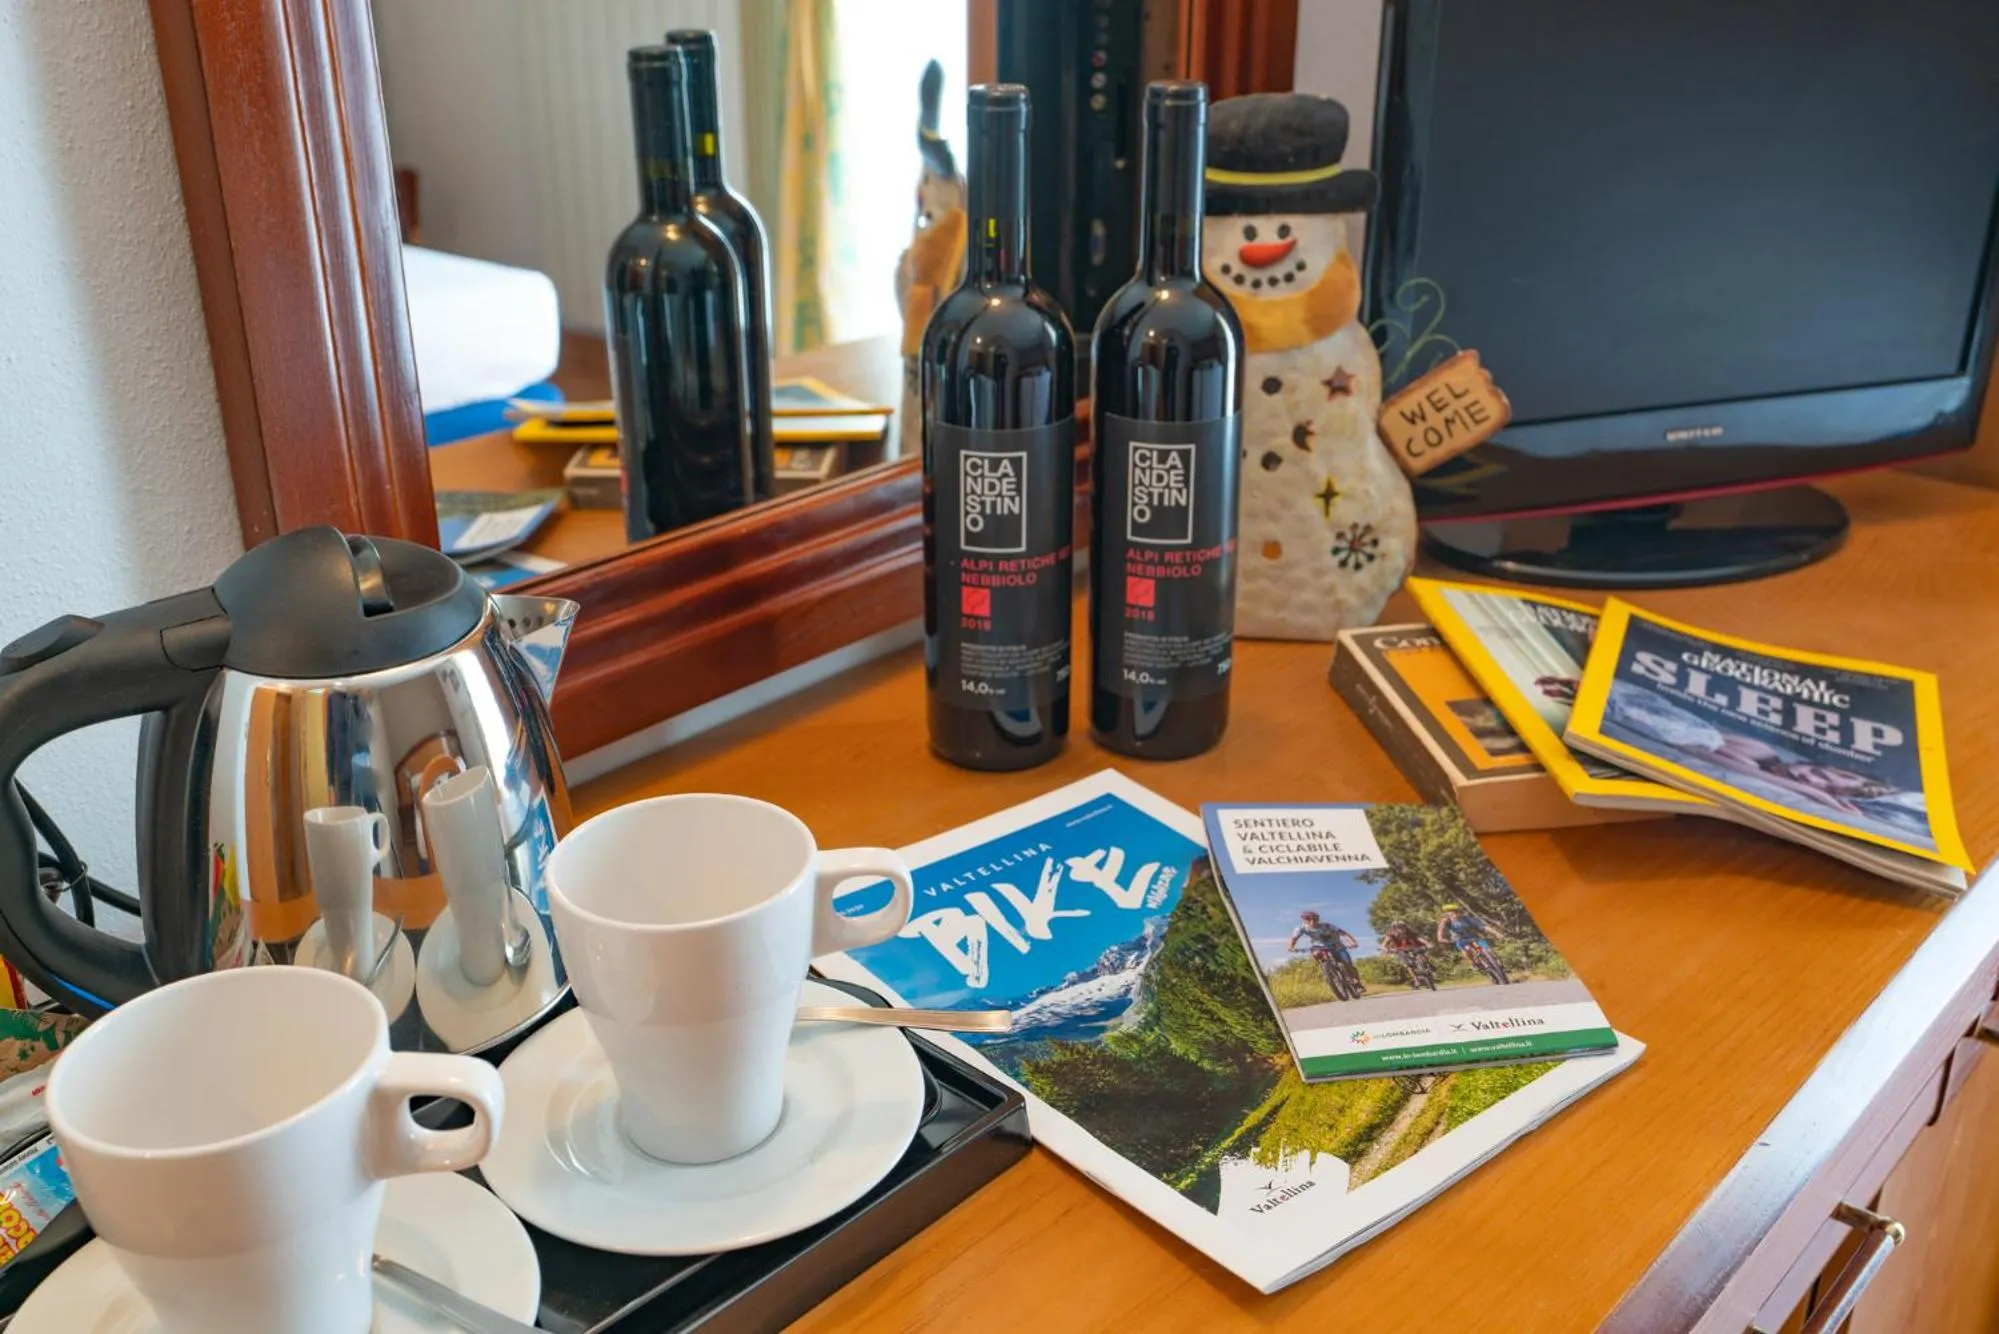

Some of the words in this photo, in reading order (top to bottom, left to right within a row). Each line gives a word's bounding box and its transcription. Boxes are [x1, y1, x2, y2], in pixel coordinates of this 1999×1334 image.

[1399, 382, 1470, 425] WEL
[1405, 400, 1491, 458] COME
[965, 457, 1015, 476] CLA
[1134, 449, 1183, 469] CLA
[965, 475, 1017, 496] NDE
[1134, 467, 1185, 488] NDE
[965, 494, 1020, 515] STIN
[1133, 486, 1187, 507] STIN
[961, 558, 993, 571] ALPI
[998, 552, 1057, 572] RETICHE
[1126, 548, 1159, 562] ALPI
[1164, 545, 1221, 563] RETICHE
[961, 571, 1037, 588] NEBBIOLO
[1126, 563, 1201, 578] NEBBIOLO
[1681, 651, 1850, 709] GEOGRAPHIC
[1702, 650, 1834, 694] NATIONAL
[1630, 650, 1904, 756] SLEEP
[1233, 817, 1315, 830] SENTIERO
[1237, 830, 1337, 842] VALTELLINA
[1242, 845, 1253, 854] &
[1258, 842, 1343, 854] CICLABILE
[923, 842, 1053, 897] VALTELLINA
[1244, 852, 1372, 866] VALCHIAVENNA
[897, 847, 1160, 988] BIKE
[1469, 1016, 1545, 1031] Valtellina
[1250, 1179, 1316, 1215] Valtellina
